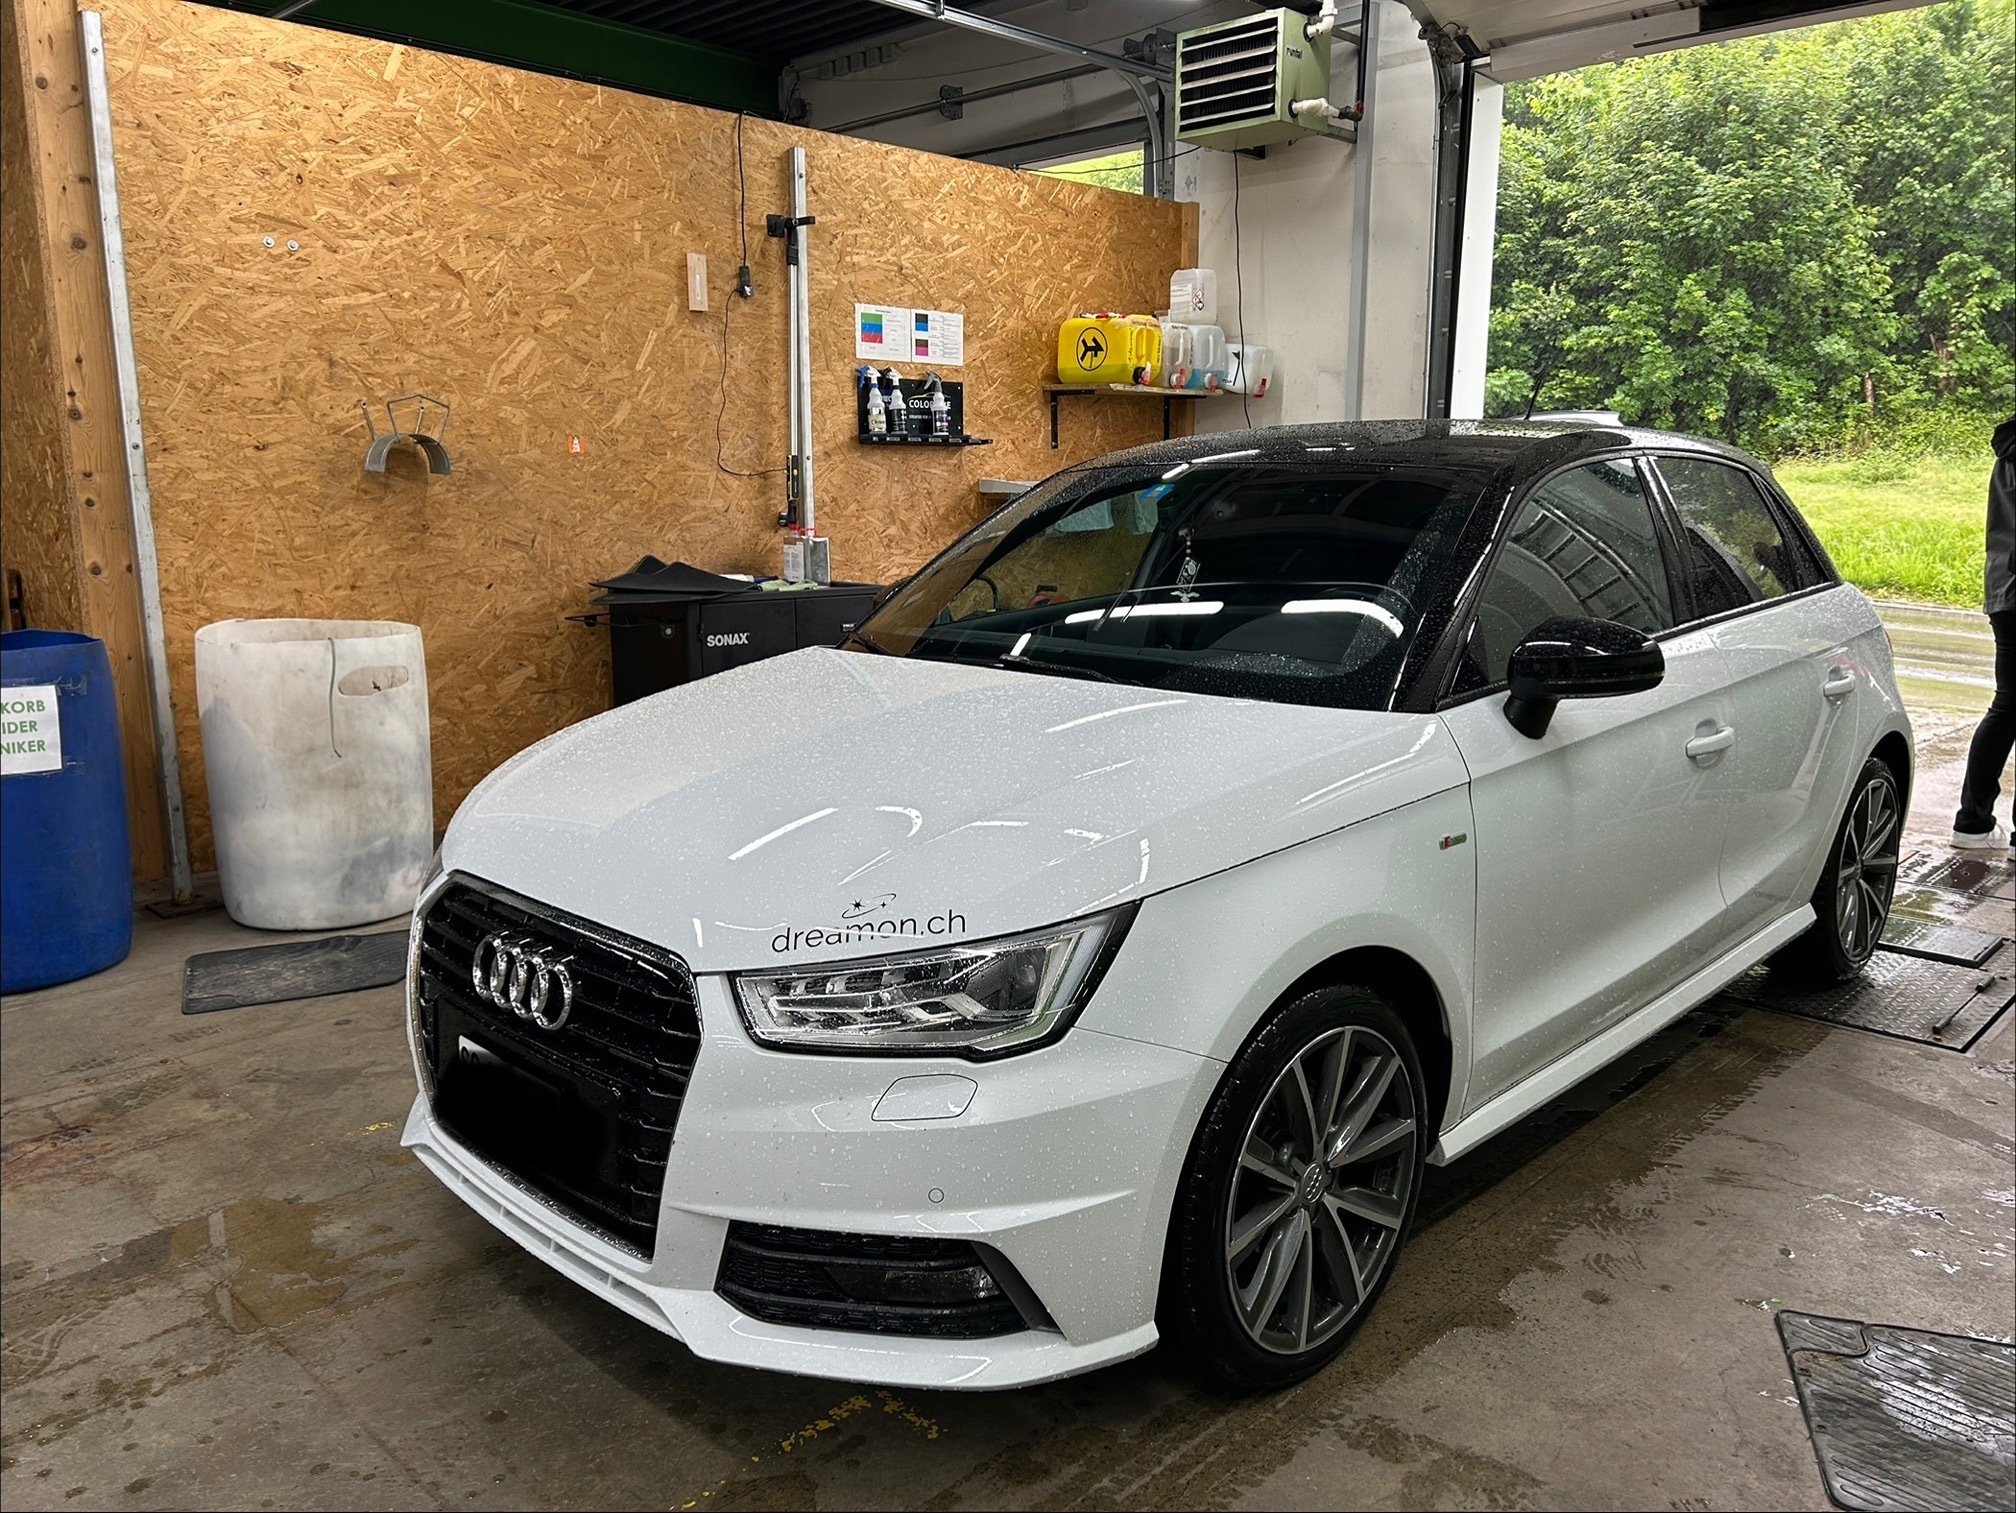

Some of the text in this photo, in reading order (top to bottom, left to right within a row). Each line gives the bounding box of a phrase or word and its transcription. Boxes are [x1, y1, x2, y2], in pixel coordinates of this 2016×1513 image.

[706, 632, 749, 647] SONAX
[1, 699, 46, 715] KORB
[2, 720, 38, 735] IDER
[1, 739, 46, 755] NIKER
[771, 908, 966, 953] dreamon.ch
